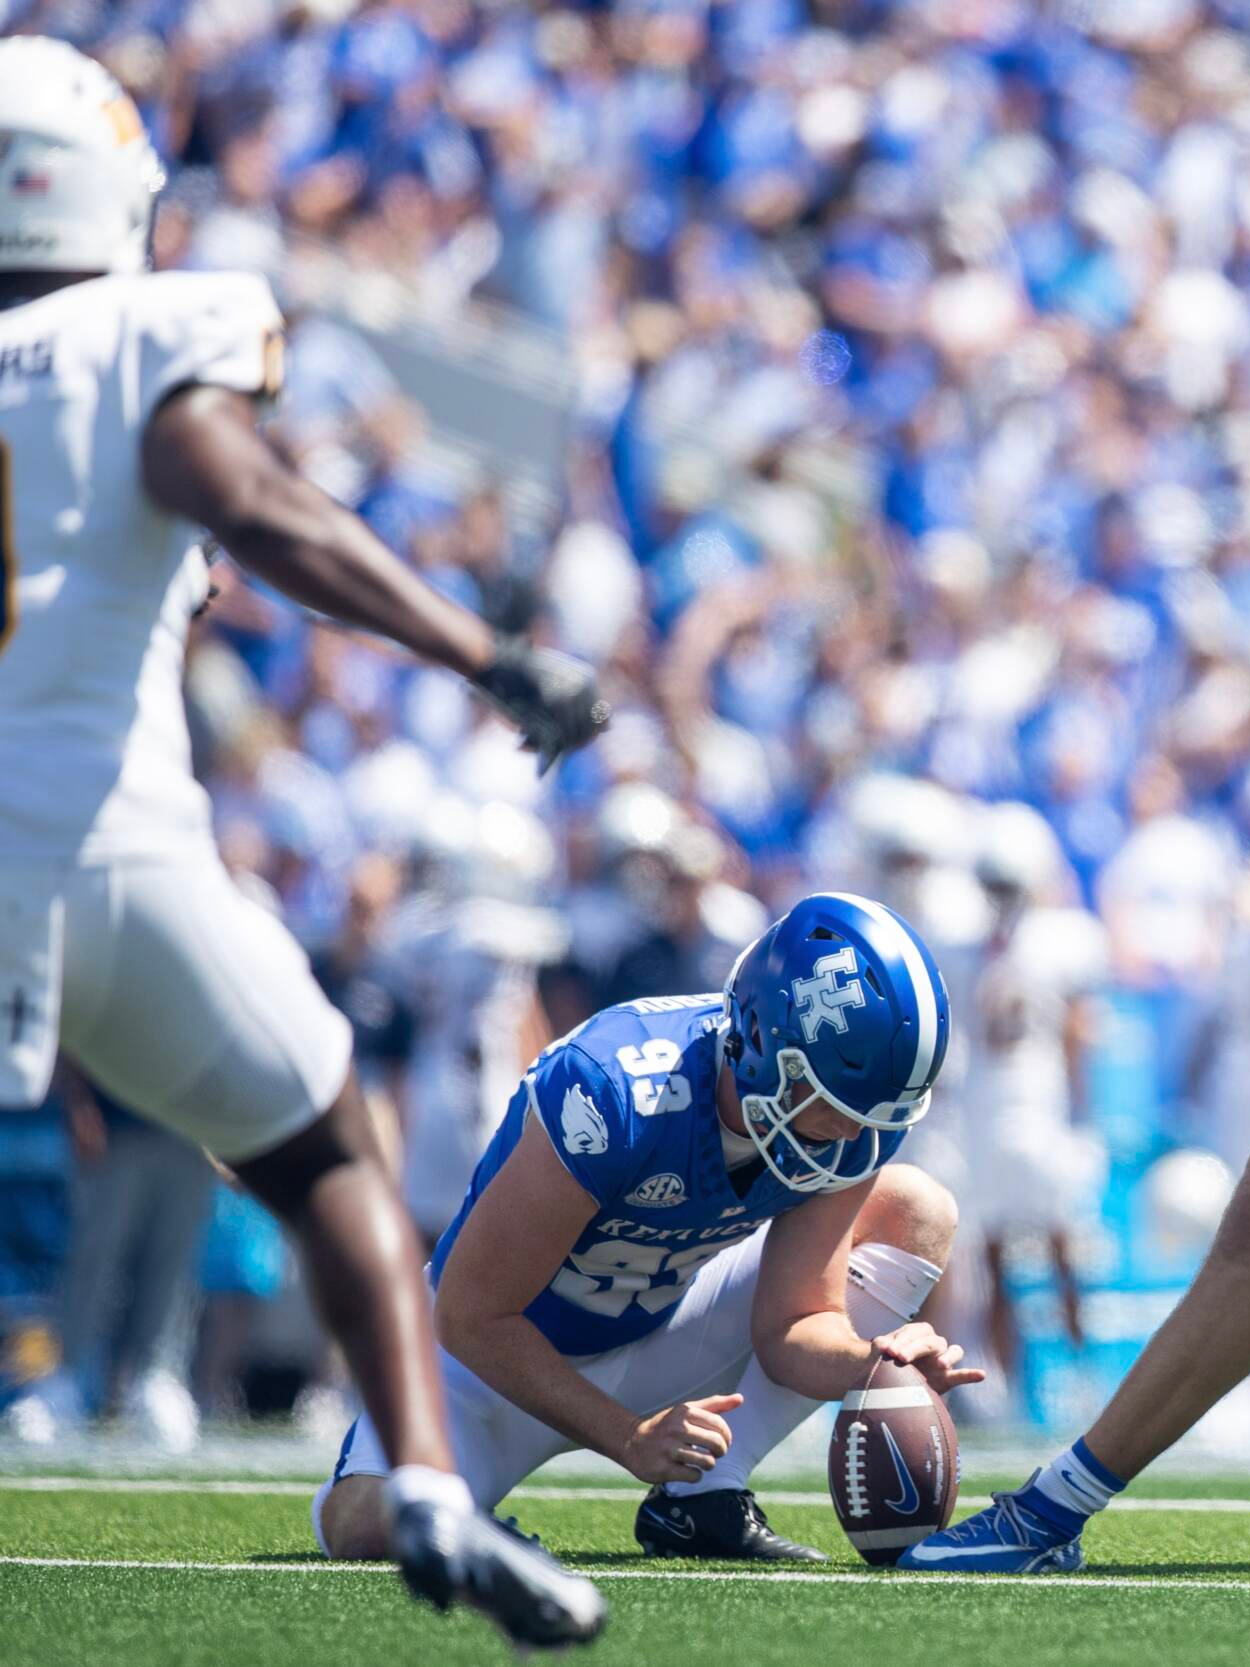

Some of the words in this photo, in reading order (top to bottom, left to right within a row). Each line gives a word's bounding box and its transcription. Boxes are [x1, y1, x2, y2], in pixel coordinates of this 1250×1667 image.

[791, 947, 866, 1044] UK
[616, 1038, 693, 1117] 93
[638, 1175, 681, 1202] SEC
[597, 1217, 767, 1241] KENTUC
